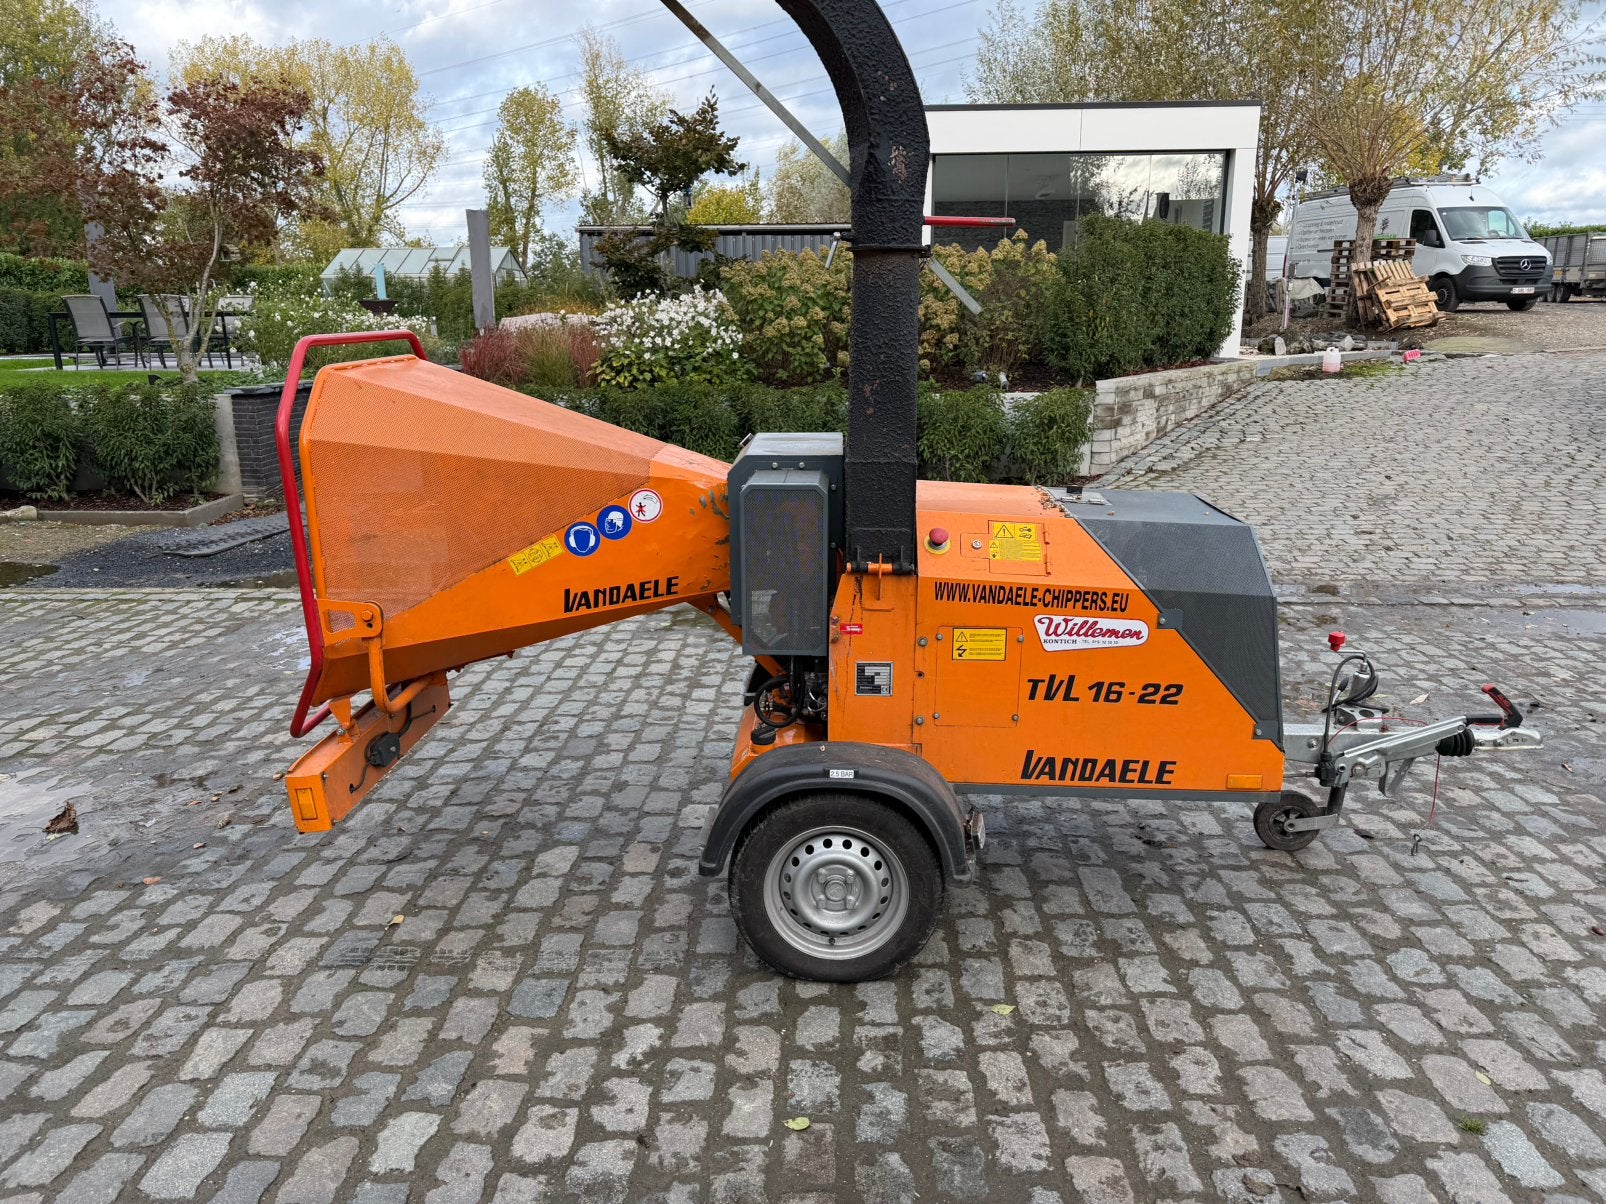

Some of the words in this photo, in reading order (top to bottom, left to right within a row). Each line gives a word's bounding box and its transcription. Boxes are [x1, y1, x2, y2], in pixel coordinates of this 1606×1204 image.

[564, 575, 679, 613] VANDAELE
[934, 581, 1129, 612] WWW.VANDAELE-CHIPPERS.EU
[1037, 616, 1144, 640] Willemen
[1027, 674, 1080, 702] TVL
[1020, 749, 1177, 785] VANDAELE
